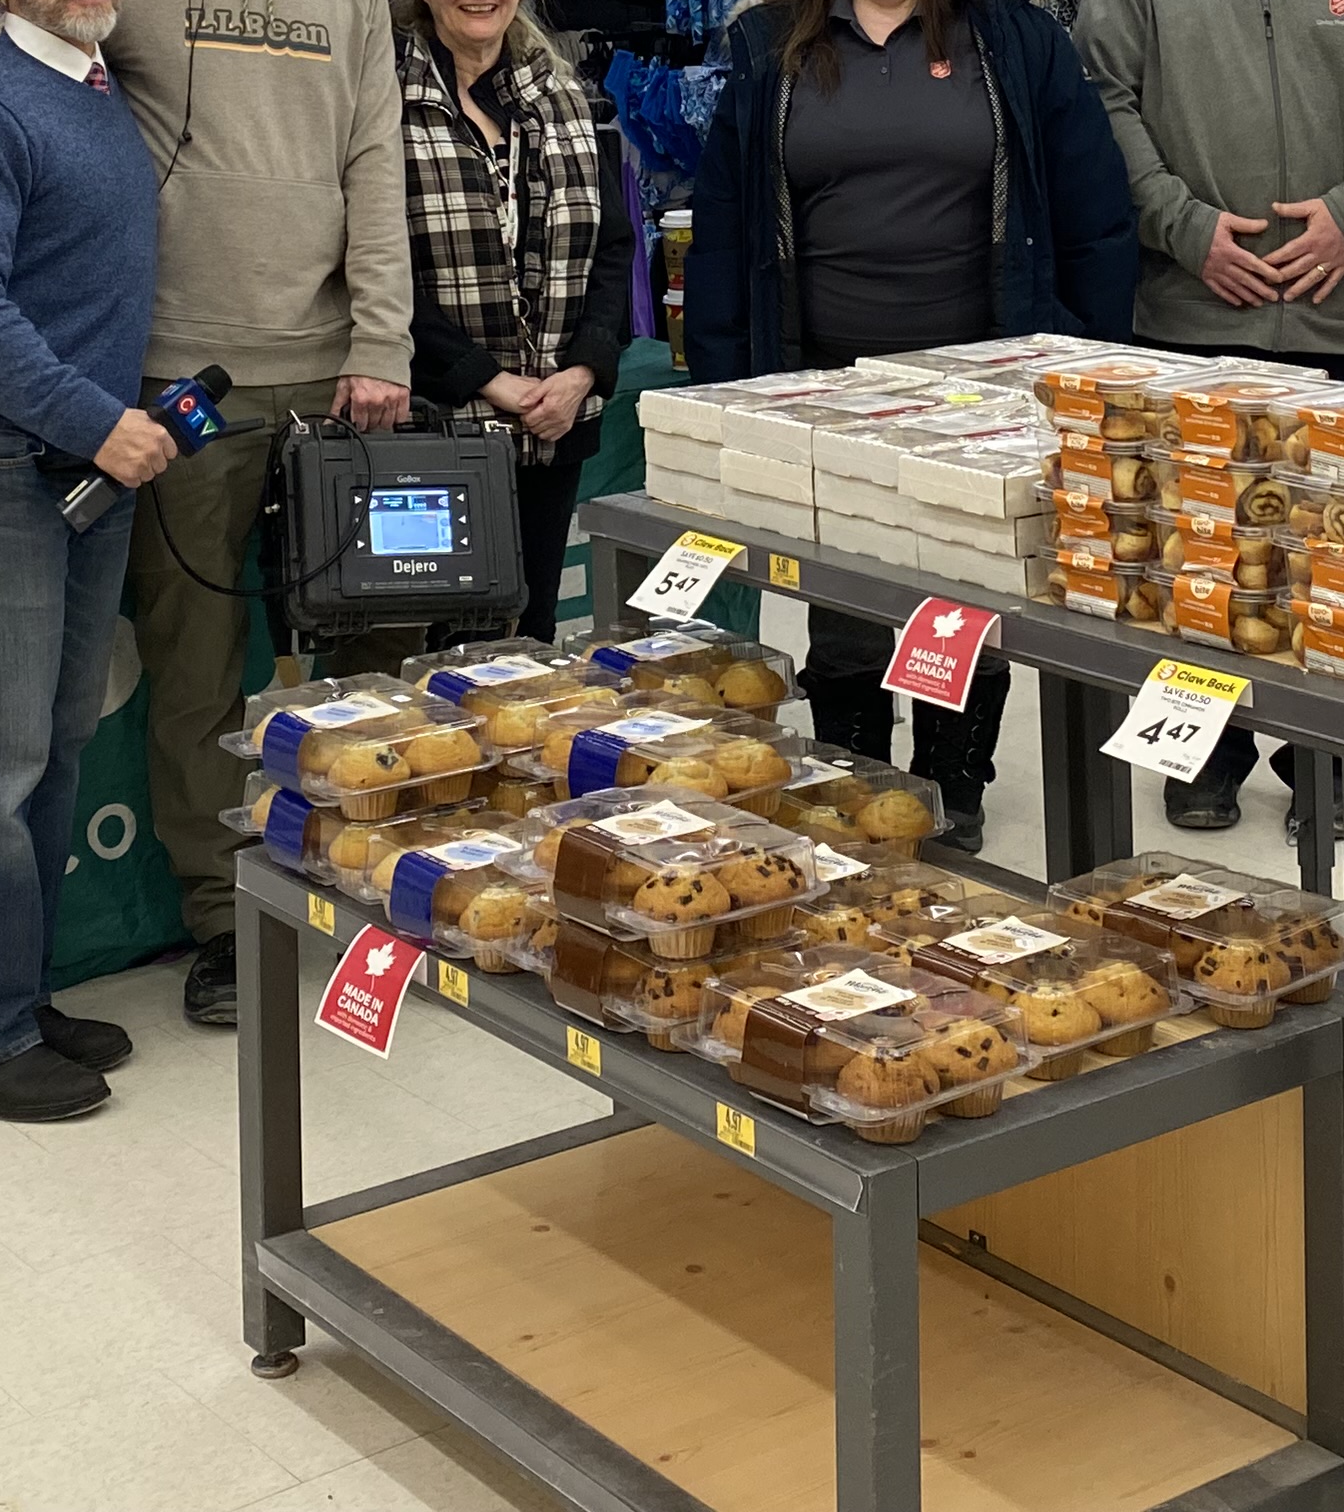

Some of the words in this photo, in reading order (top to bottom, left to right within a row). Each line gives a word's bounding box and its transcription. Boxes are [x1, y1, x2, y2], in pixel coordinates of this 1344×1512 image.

[178, 396, 218, 437] CTV
[397, 475, 421, 483] GoBox
[694, 539, 716, 550] Claw
[715, 544, 735, 555] Back
[393, 560, 437, 575] Dejero
[910, 647, 944, 665] MADE
[943, 655, 958, 669] IN
[905, 659, 953, 683] CANADA
[1177, 671, 1207, 686] Claw
[1206, 678, 1237, 694] Back
[1162, 686, 1183, 699] SAVE
[1185, 690, 1211, 705] $0.50
[445, 968, 459, 985] 4.97
[342, 982, 372, 1006] MADE
[371, 998, 384, 1013] IN
[337, 995, 379, 1027] CANADA
[574, 1033, 589, 1054] 4.97
[726, 1108, 741, 1133] 4.97
